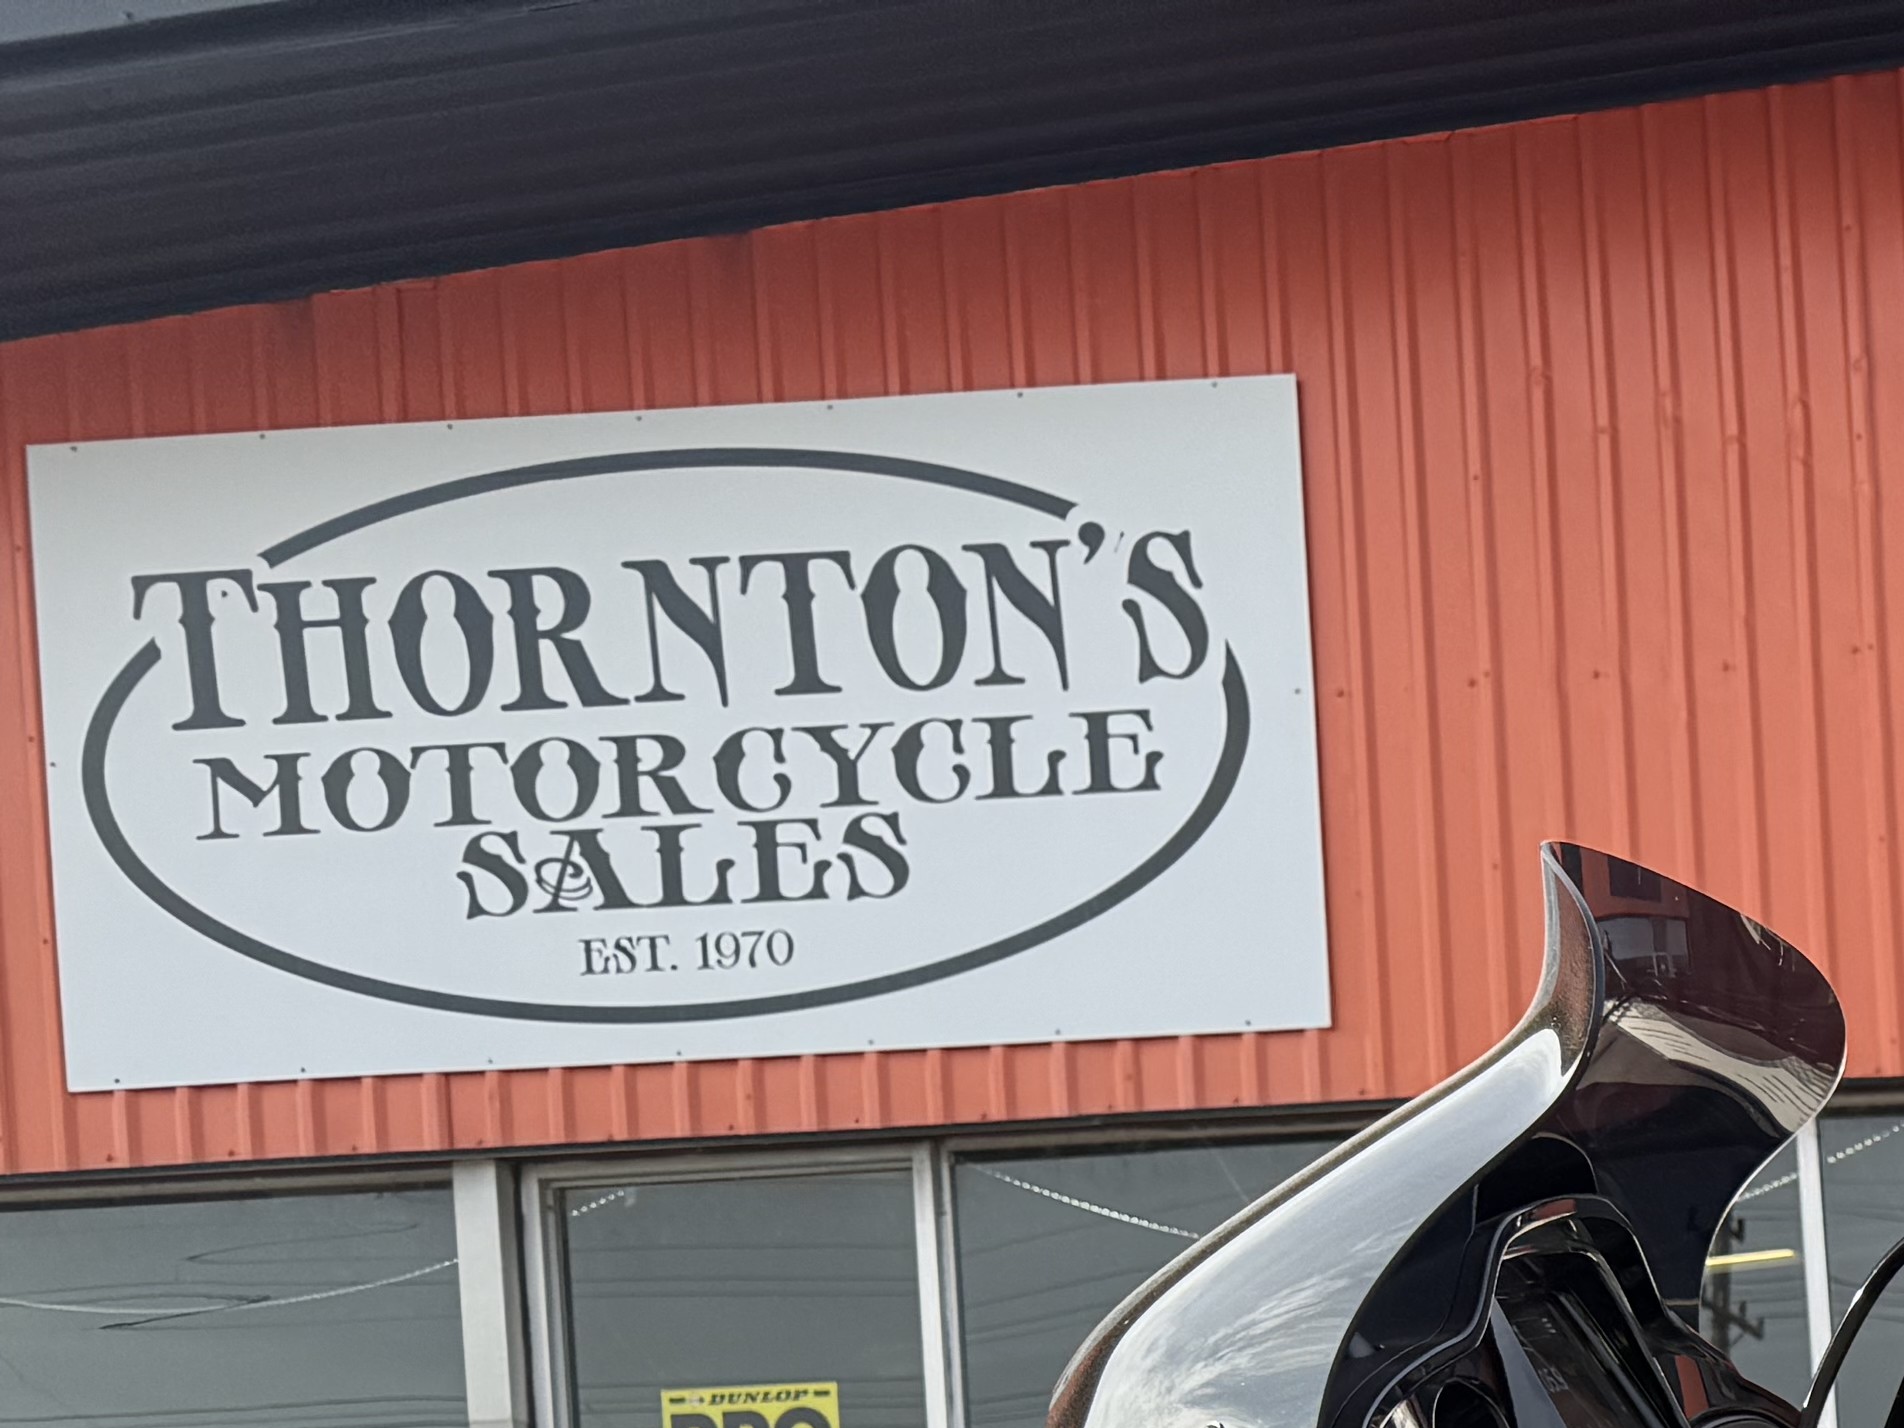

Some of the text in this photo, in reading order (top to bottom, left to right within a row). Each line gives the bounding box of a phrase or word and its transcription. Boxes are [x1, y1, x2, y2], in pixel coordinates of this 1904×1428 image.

[131, 521, 1211, 731] THORNTON'S
[194, 708, 1164, 840] MOTORCYCLE
[456, 810, 911, 921] SALES
[579, 928, 796, 977] EST. 1970
[708, 1389, 809, 1406] DUNLOP
